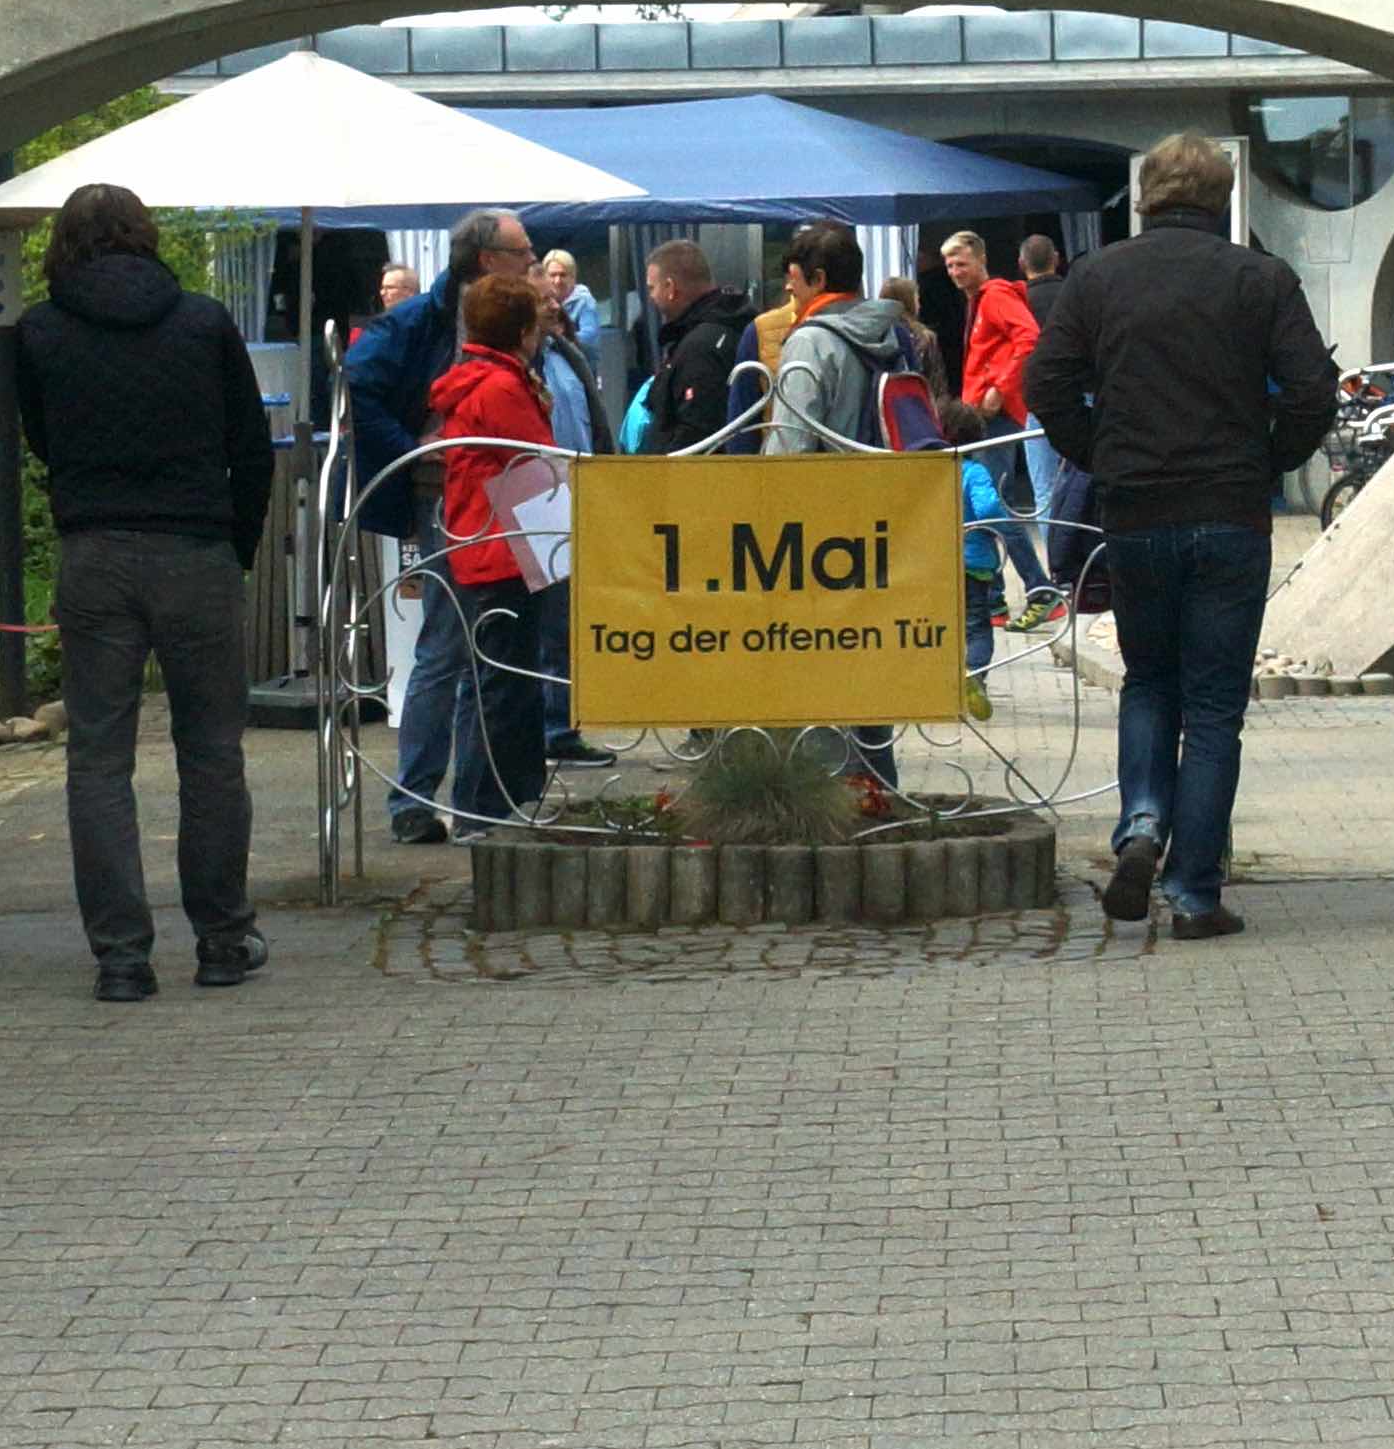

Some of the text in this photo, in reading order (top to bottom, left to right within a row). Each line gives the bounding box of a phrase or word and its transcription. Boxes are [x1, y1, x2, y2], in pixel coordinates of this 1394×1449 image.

[590, 617, 947, 661] Tag der offenen Tür
